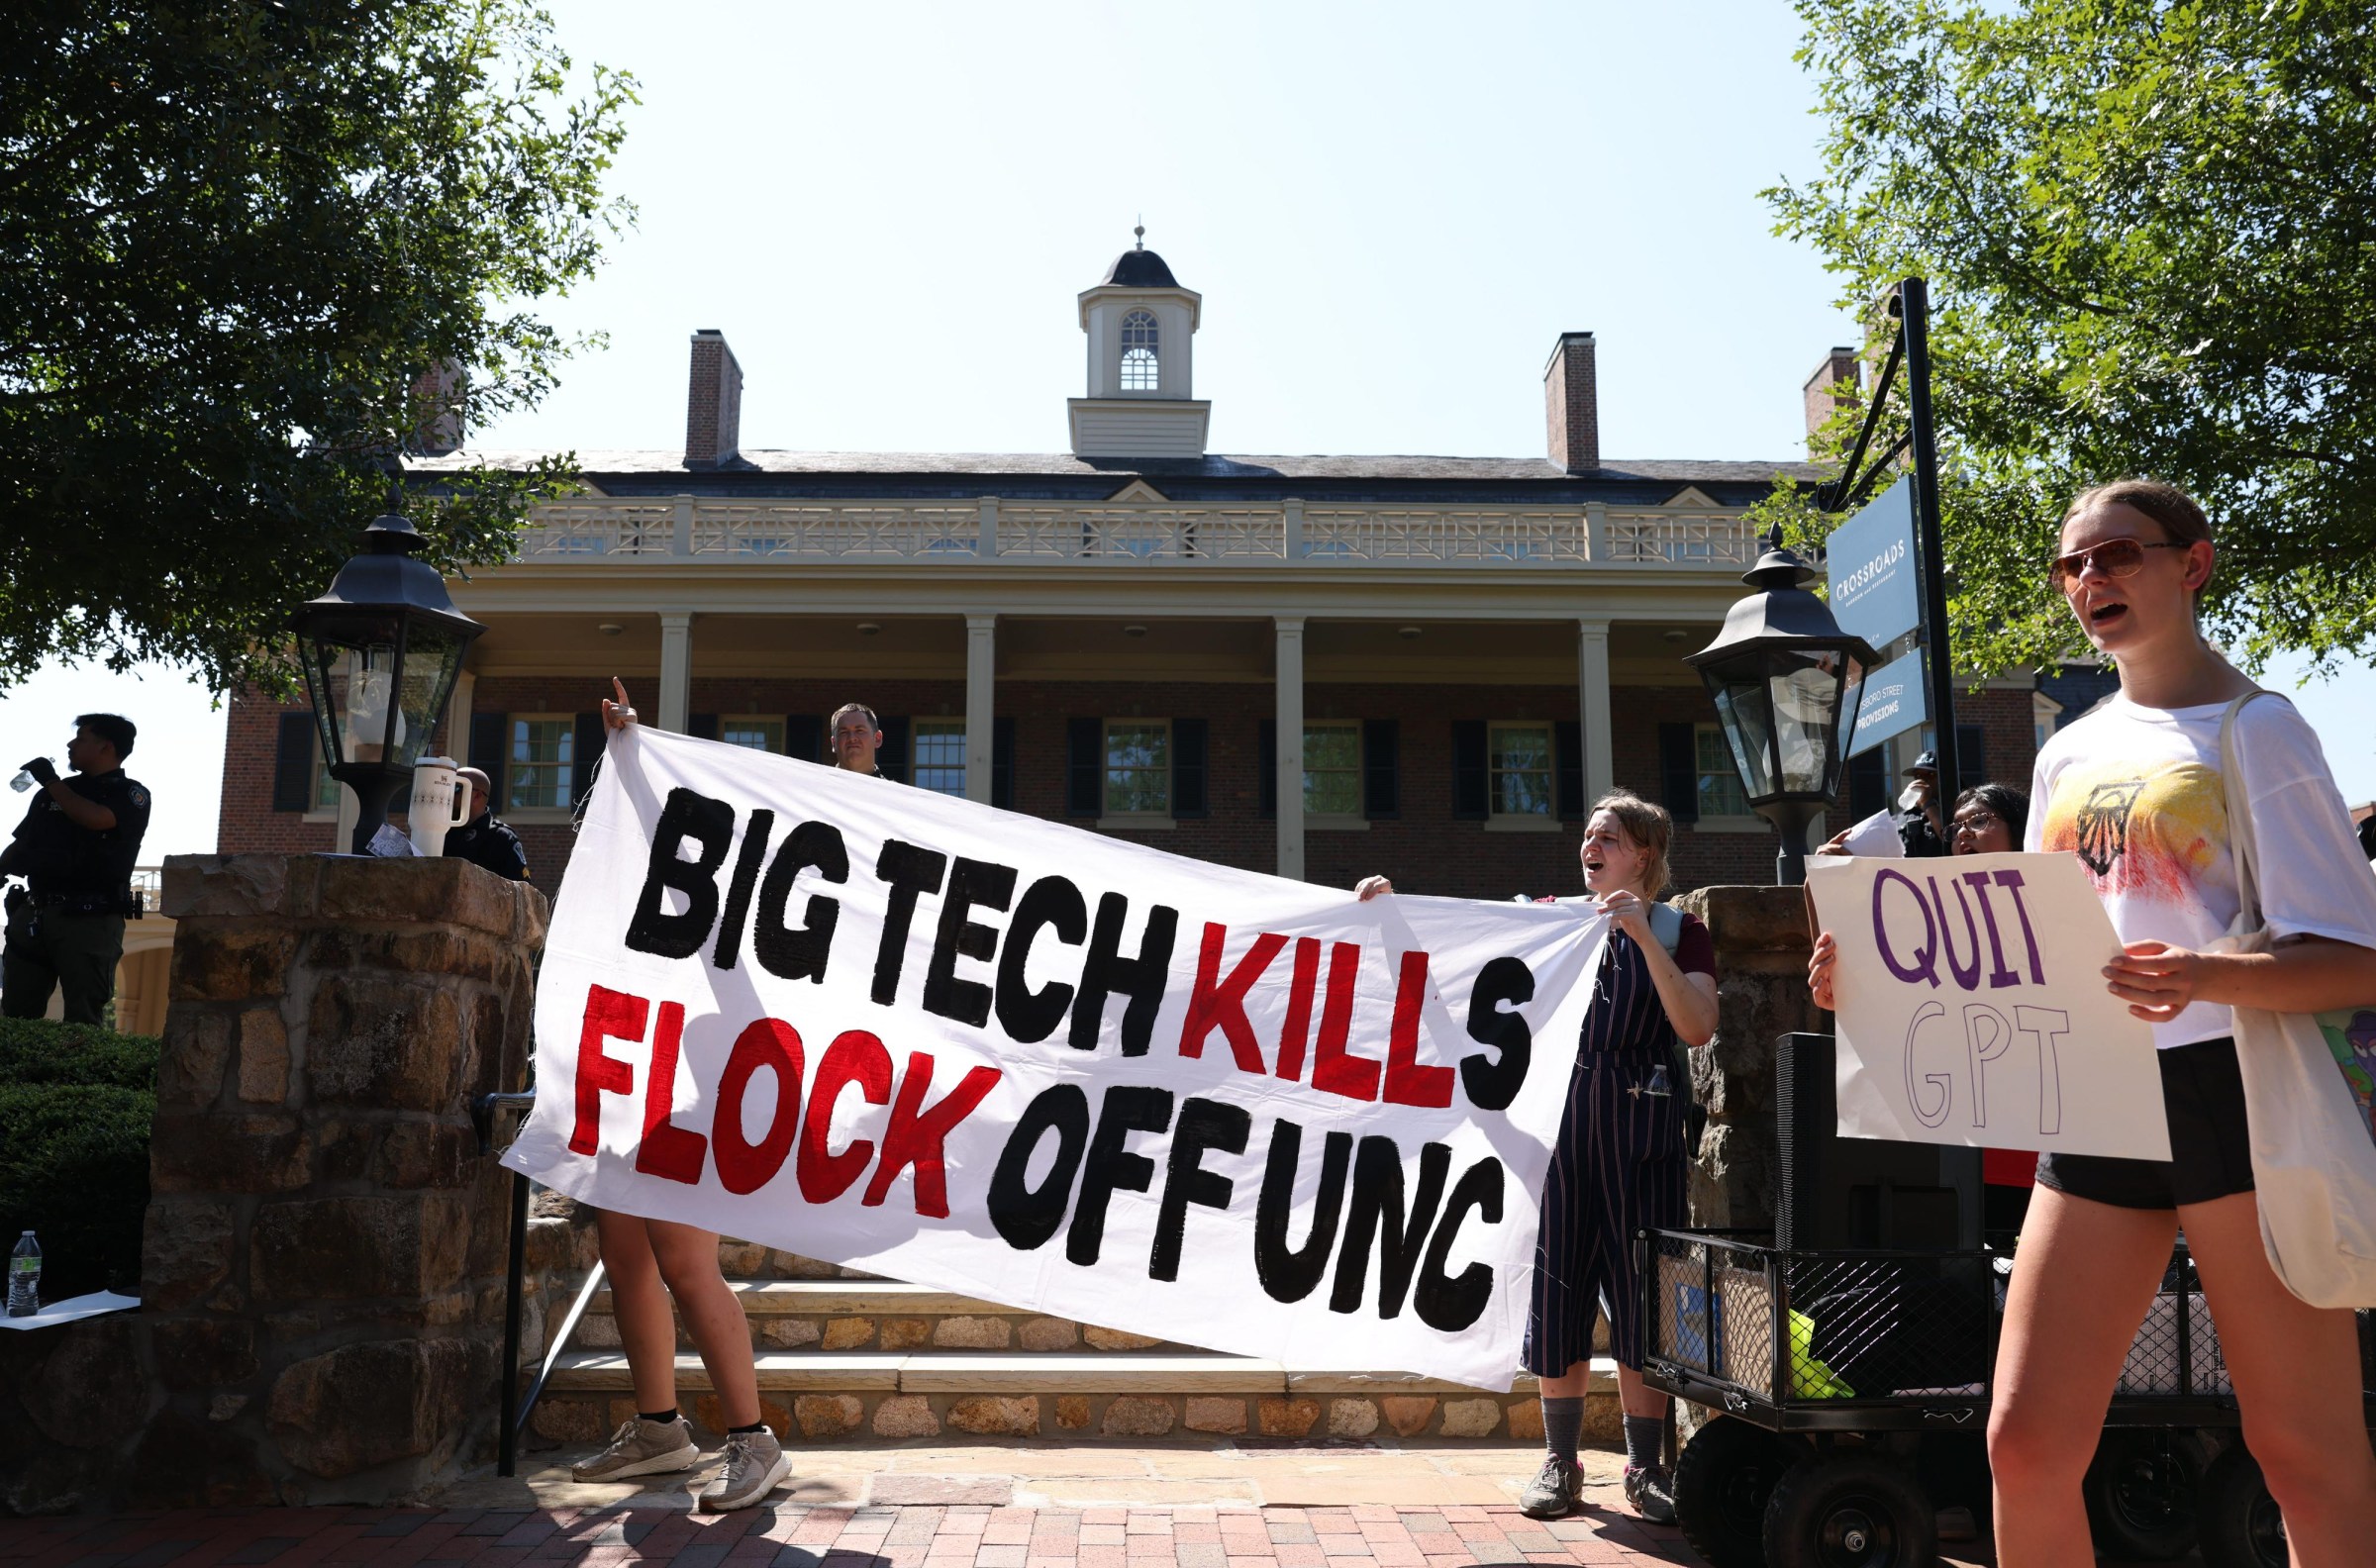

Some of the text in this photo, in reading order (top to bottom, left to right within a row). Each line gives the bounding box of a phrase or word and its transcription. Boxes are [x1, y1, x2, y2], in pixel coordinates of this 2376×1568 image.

[1835, 539, 1905, 601] CROSSROADS
[1857, 700, 1900, 731] PROVISIONS
[1882, 684, 1904, 699] STREET
[625, 787, 1535, 1111] BIG TECH KILLS
[1872, 868, 2045, 991] QUIT
[1904, 1001, 2069, 1134] GPT
[568, 983, 1505, 1332] FLOCK OFF UNC
